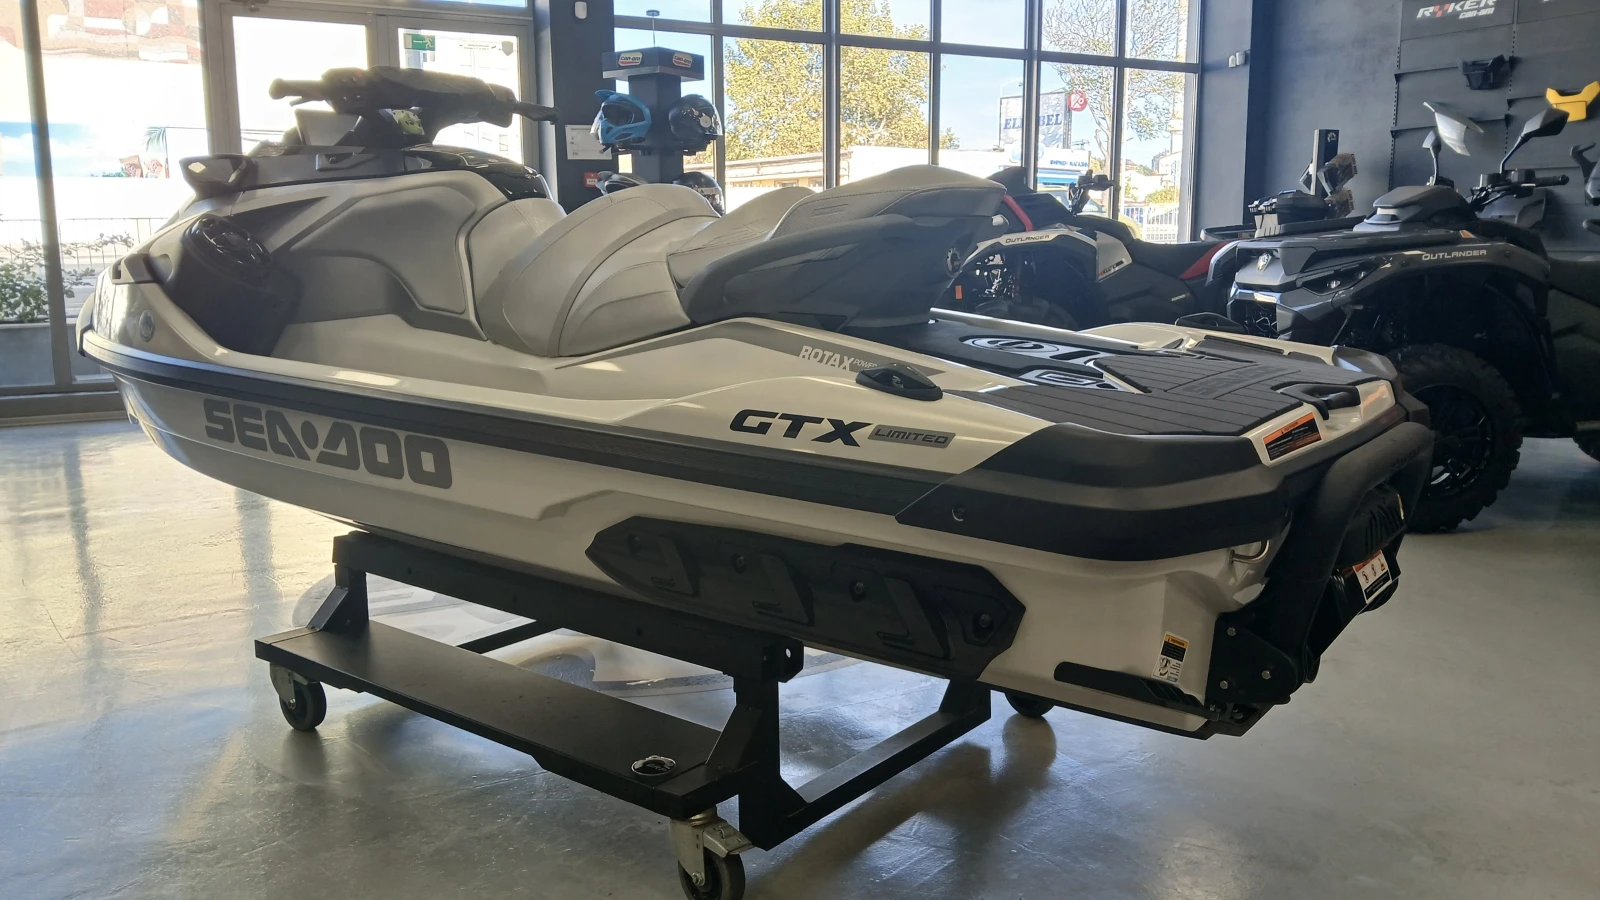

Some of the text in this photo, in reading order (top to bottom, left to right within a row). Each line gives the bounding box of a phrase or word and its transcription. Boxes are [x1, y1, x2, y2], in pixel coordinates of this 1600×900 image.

[1417, 0, 1497, 18] RYKER
[1005, 235, 1050, 243] OUTLANDER
[1422, 249, 1487, 261] OUTLANDER
[799, 345, 855, 371] ROTAX
[729, 408, 951, 448] GTX LIMITED
